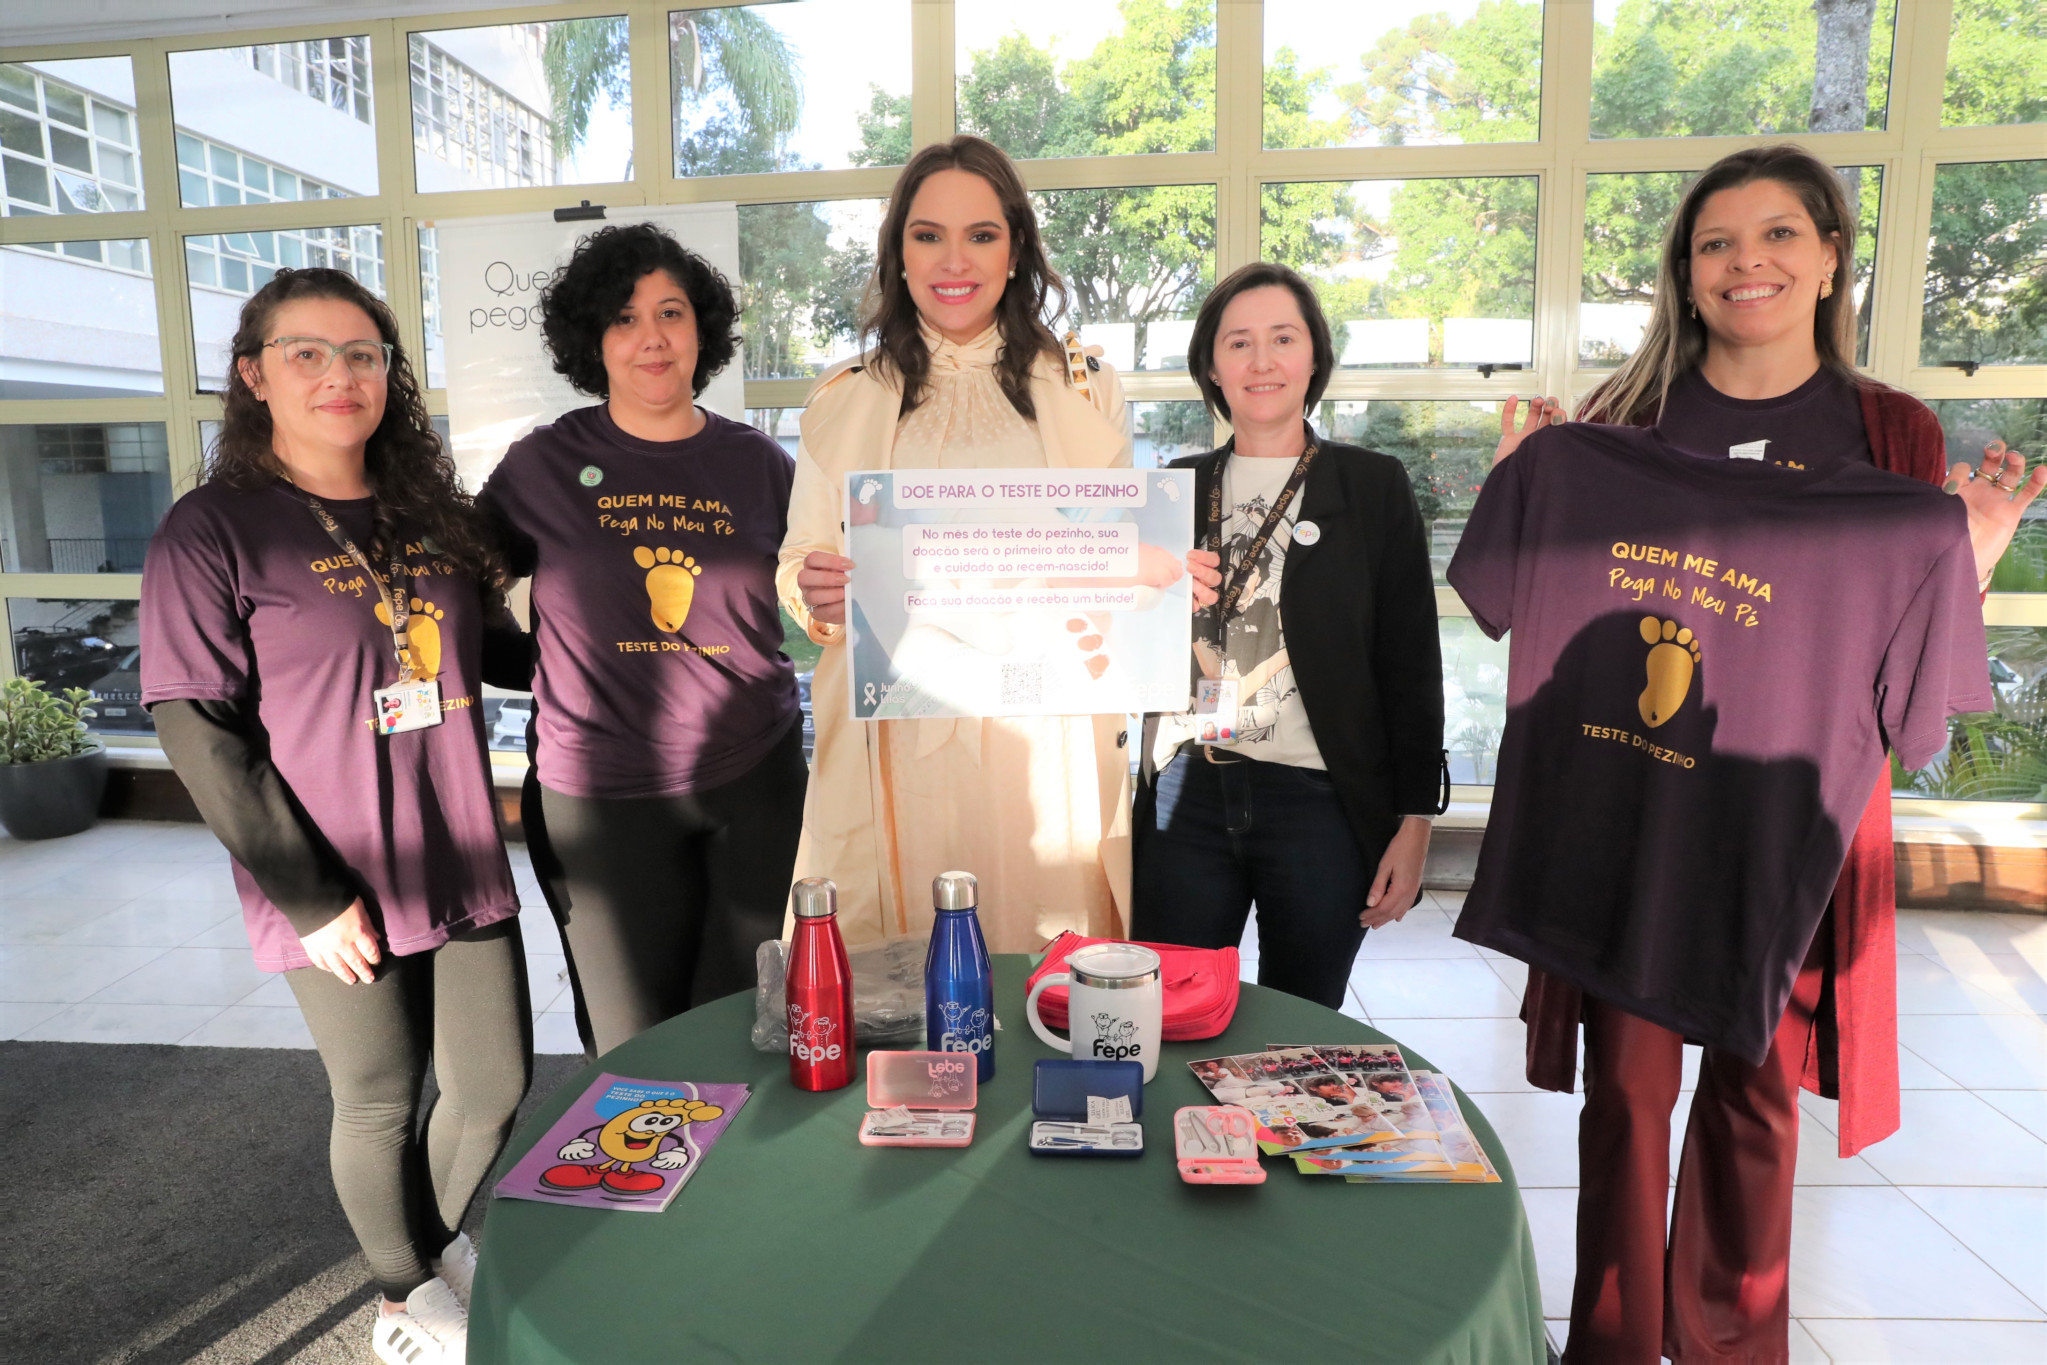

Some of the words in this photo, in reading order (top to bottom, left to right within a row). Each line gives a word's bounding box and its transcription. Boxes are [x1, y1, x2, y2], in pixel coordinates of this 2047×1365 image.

[902, 485, 934, 499] DOE
[939, 485, 976, 498] PARA
[982, 485, 994, 498] O
[1000, 484, 1042, 498] TESTE
[1047, 484, 1070, 498] DO
[1075, 484, 1139, 498] PEZINHO
[597, 494, 653, 509] QUEM
[659, 494, 687, 509] ME
[692, 499, 733, 517] AMA
[598, 514, 639, 536] Pega
[646, 513, 665, 531] No
[673, 515, 705, 533] Meu
[713, 519, 735, 536] Pé
[922, 528, 939, 540] No
[943, 529, 969, 540] mês
[972, 528, 988, 539] do
[992, 528, 1022, 539] teste
[1026, 528, 1042, 539] do
[1045, 528, 1094, 541] pezinho,
[1098, 530, 1119, 539] sua
[993, 547, 1001, 556] o
[1004, 545, 1052, 558] primeiro
[1056, 544, 1076, 556] ato
[1079, 545, 1095, 556] de
[1098, 545, 1128, 556] amor
[934, 564, 942, 574] e
[945, 562, 994, 574] cuidado
[998, 563, 1013, 573] ao
[1611, 541, 1679, 568] QUEM
[1683, 554, 1719, 578] ME
[1720, 568, 1773, 603] AMA
[323, 575, 367, 598] Pega
[1609, 567, 1655, 601] Pega
[1662, 577, 1682, 600] No
[1691, 586, 1726, 615] Meu
[1734, 603, 1759, 628] Pé
[941, 597, 962, 606] sua
[1016, 596, 1023, 605] e
[1027, 593, 1069, 605] receba
[1073, 595, 1091, 604] um
[1095, 592, 1134, 604] brinde!
[617, 641, 658, 652] TESTE
[661, 641, 680, 652] DO
[1582, 724, 1630, 743] TESTE
[1632, 734, 1648, 751] DO
[790, 1034, 841, 1067] Fepe
[1093, 1039, 1141, 1061] Fepe
